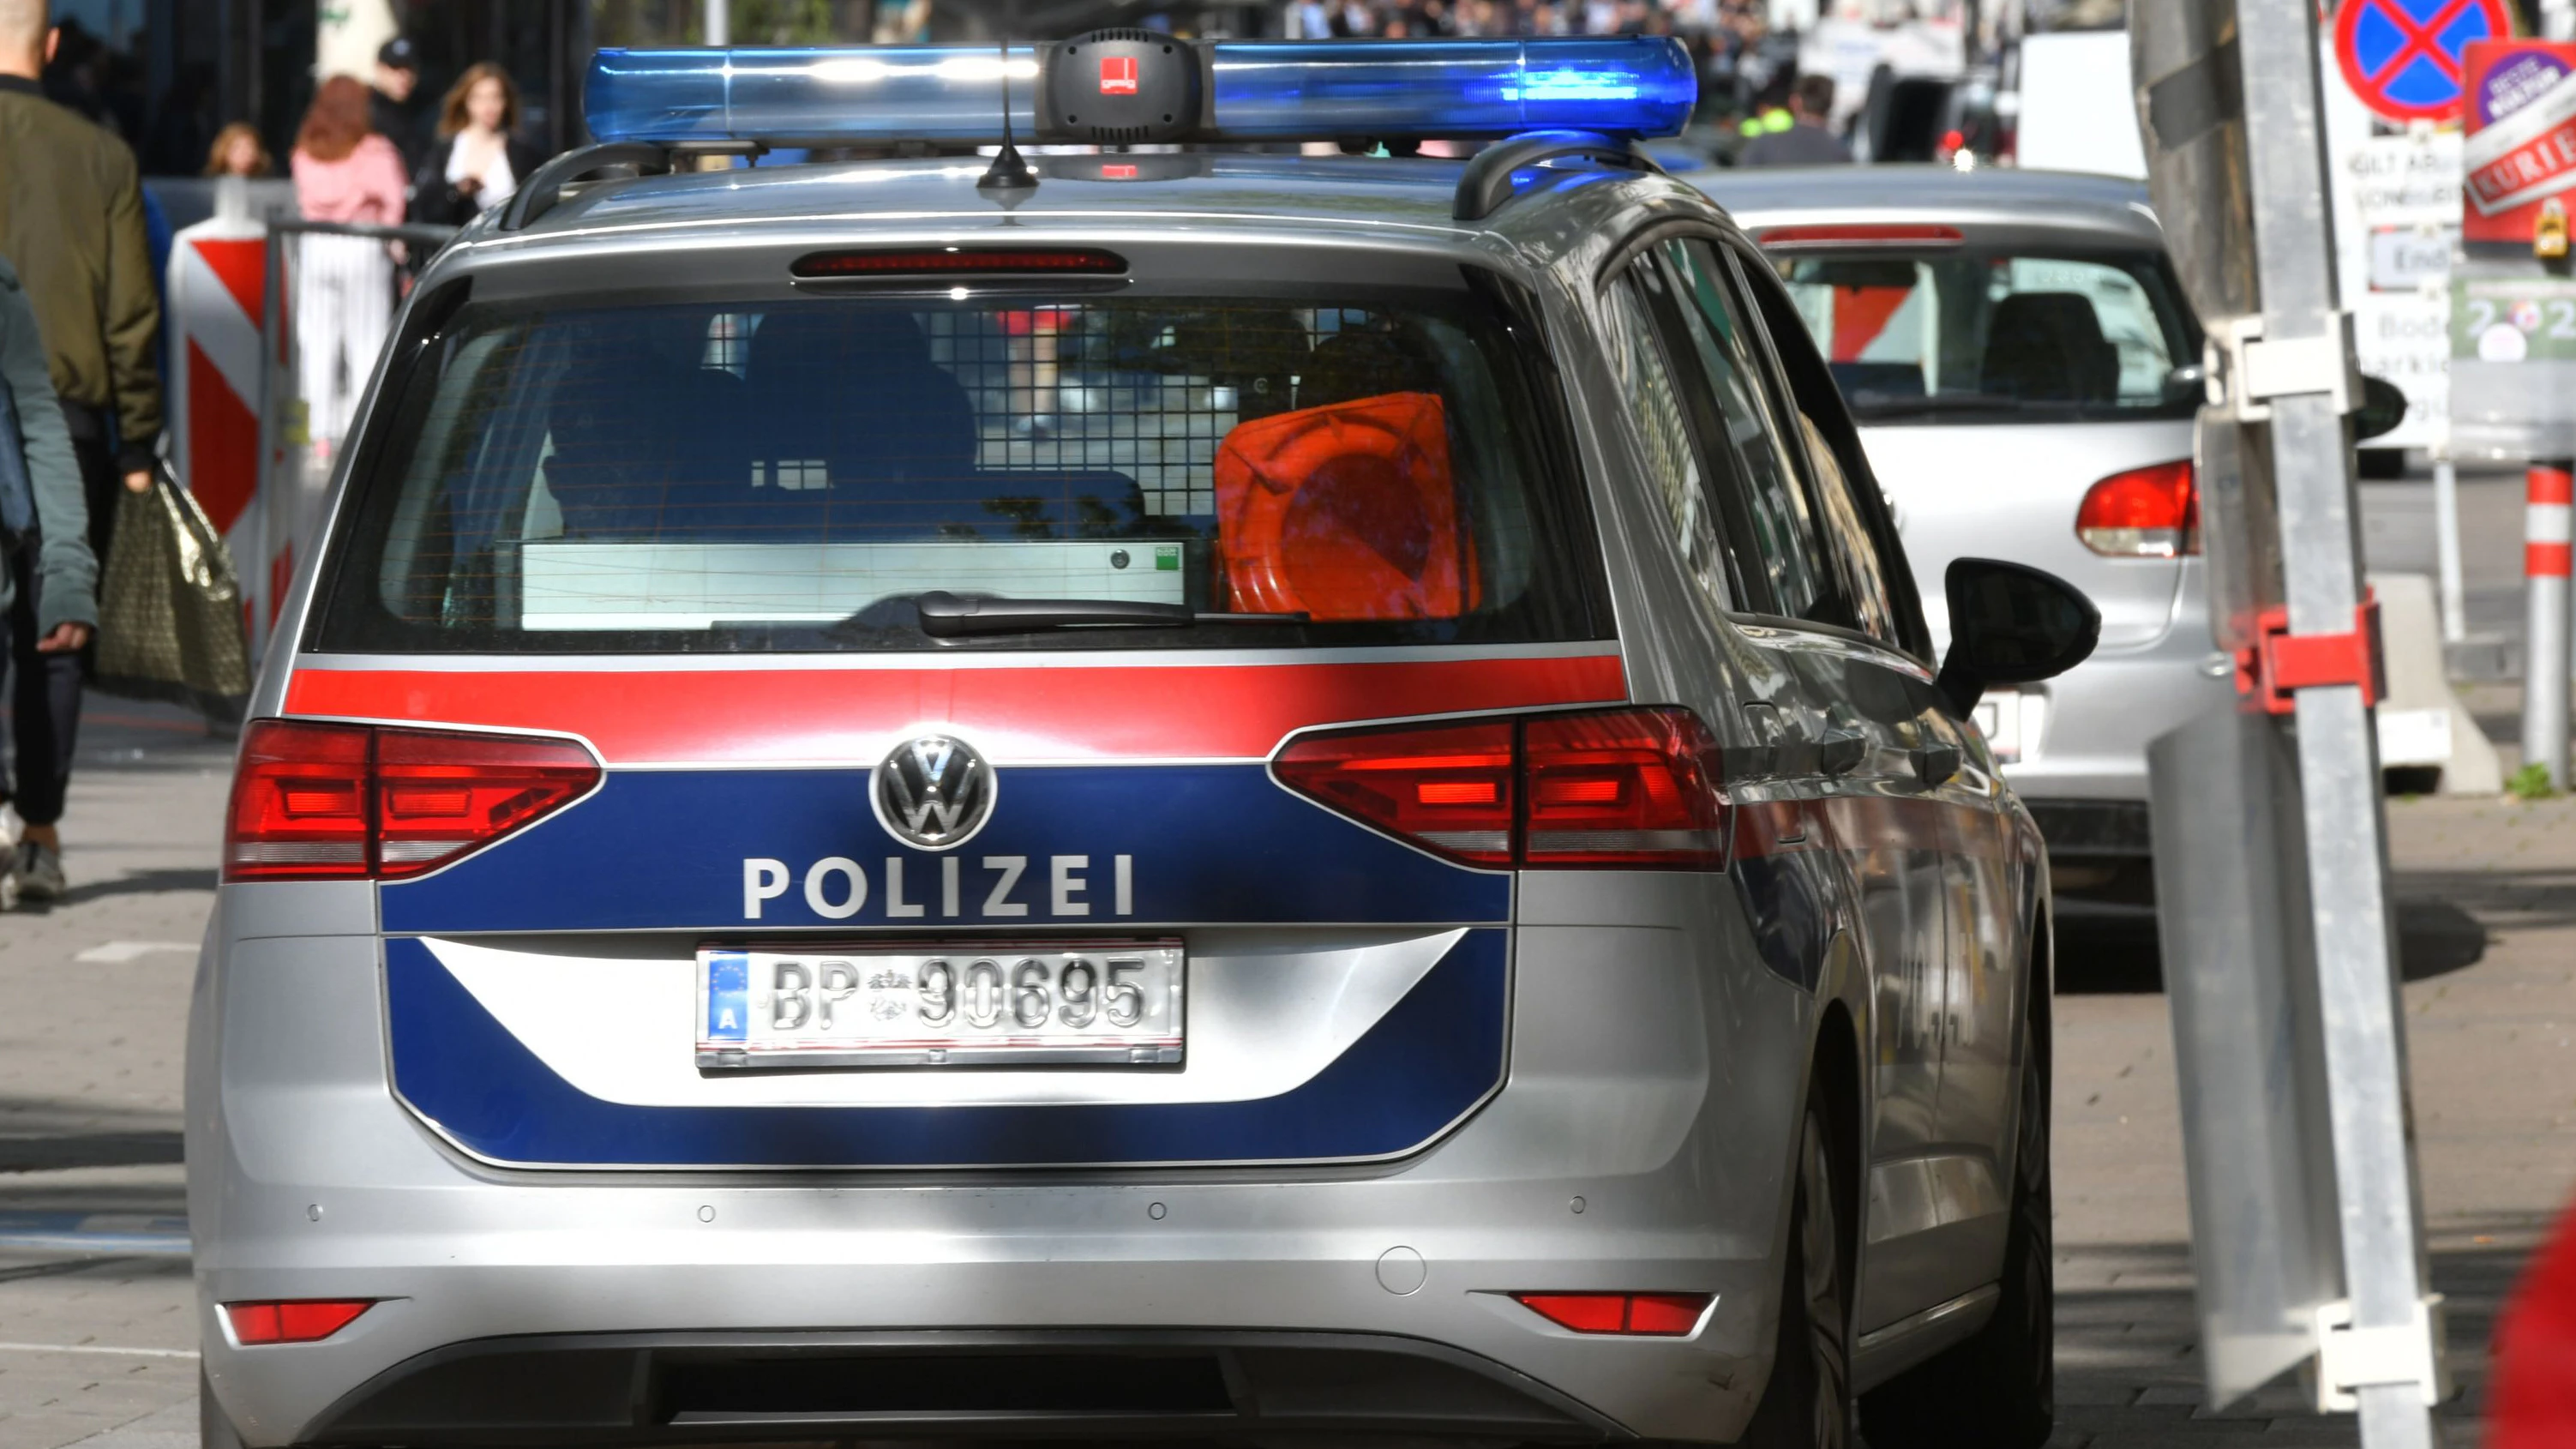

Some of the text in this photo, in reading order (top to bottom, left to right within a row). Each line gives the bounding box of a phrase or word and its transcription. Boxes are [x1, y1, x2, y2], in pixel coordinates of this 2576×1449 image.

[744, 855, 1132, 920] POLIZEI
[718, 958, 1145, 1031] A BP 90695
